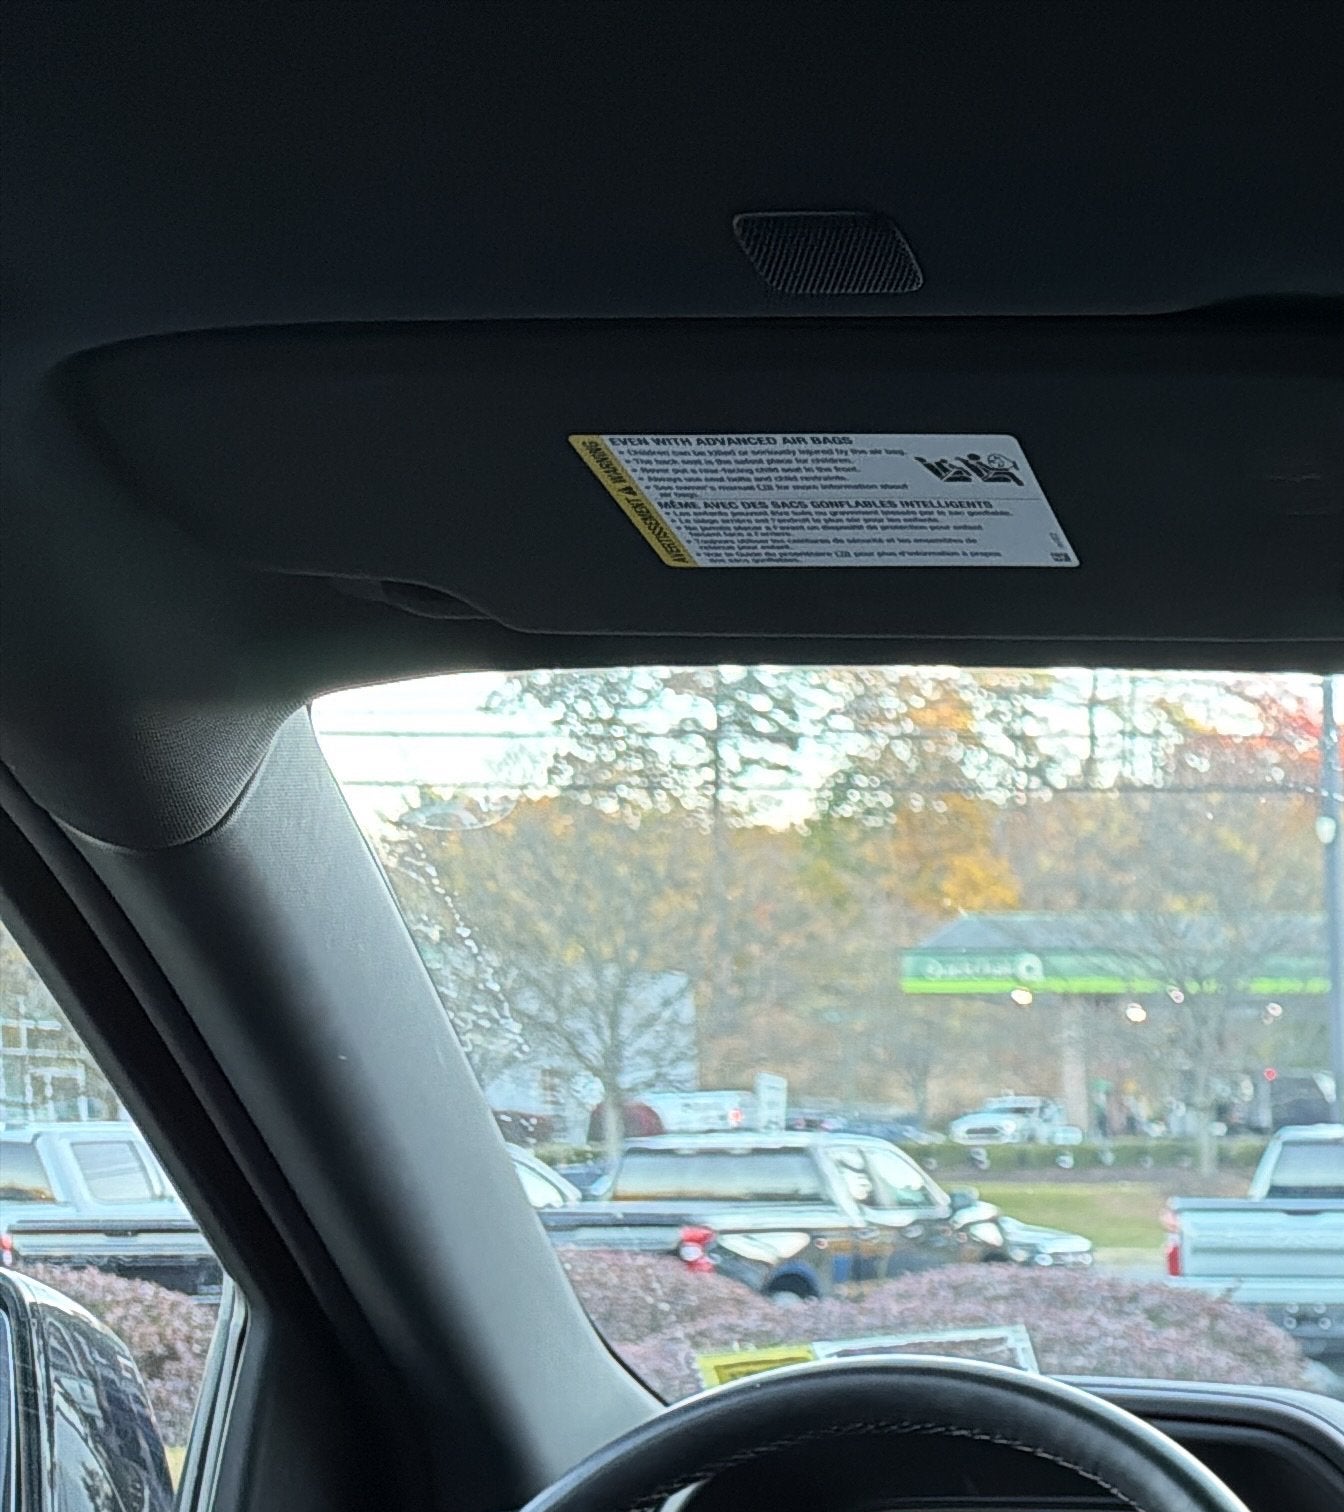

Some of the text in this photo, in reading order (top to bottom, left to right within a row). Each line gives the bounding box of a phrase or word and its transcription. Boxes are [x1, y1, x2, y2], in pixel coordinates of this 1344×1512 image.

[609, 436, 853, 447] EVEN WITH ADVANCED AIR BAGS
[703, 501, 739, 510] AVEC
[741, 501, 770, 510] DES
[771, 501, 808, 510] SACS
[811, 500, 898, 509] GONFLABLES
[900, 500, 993, 509] INTELLIGENTS
